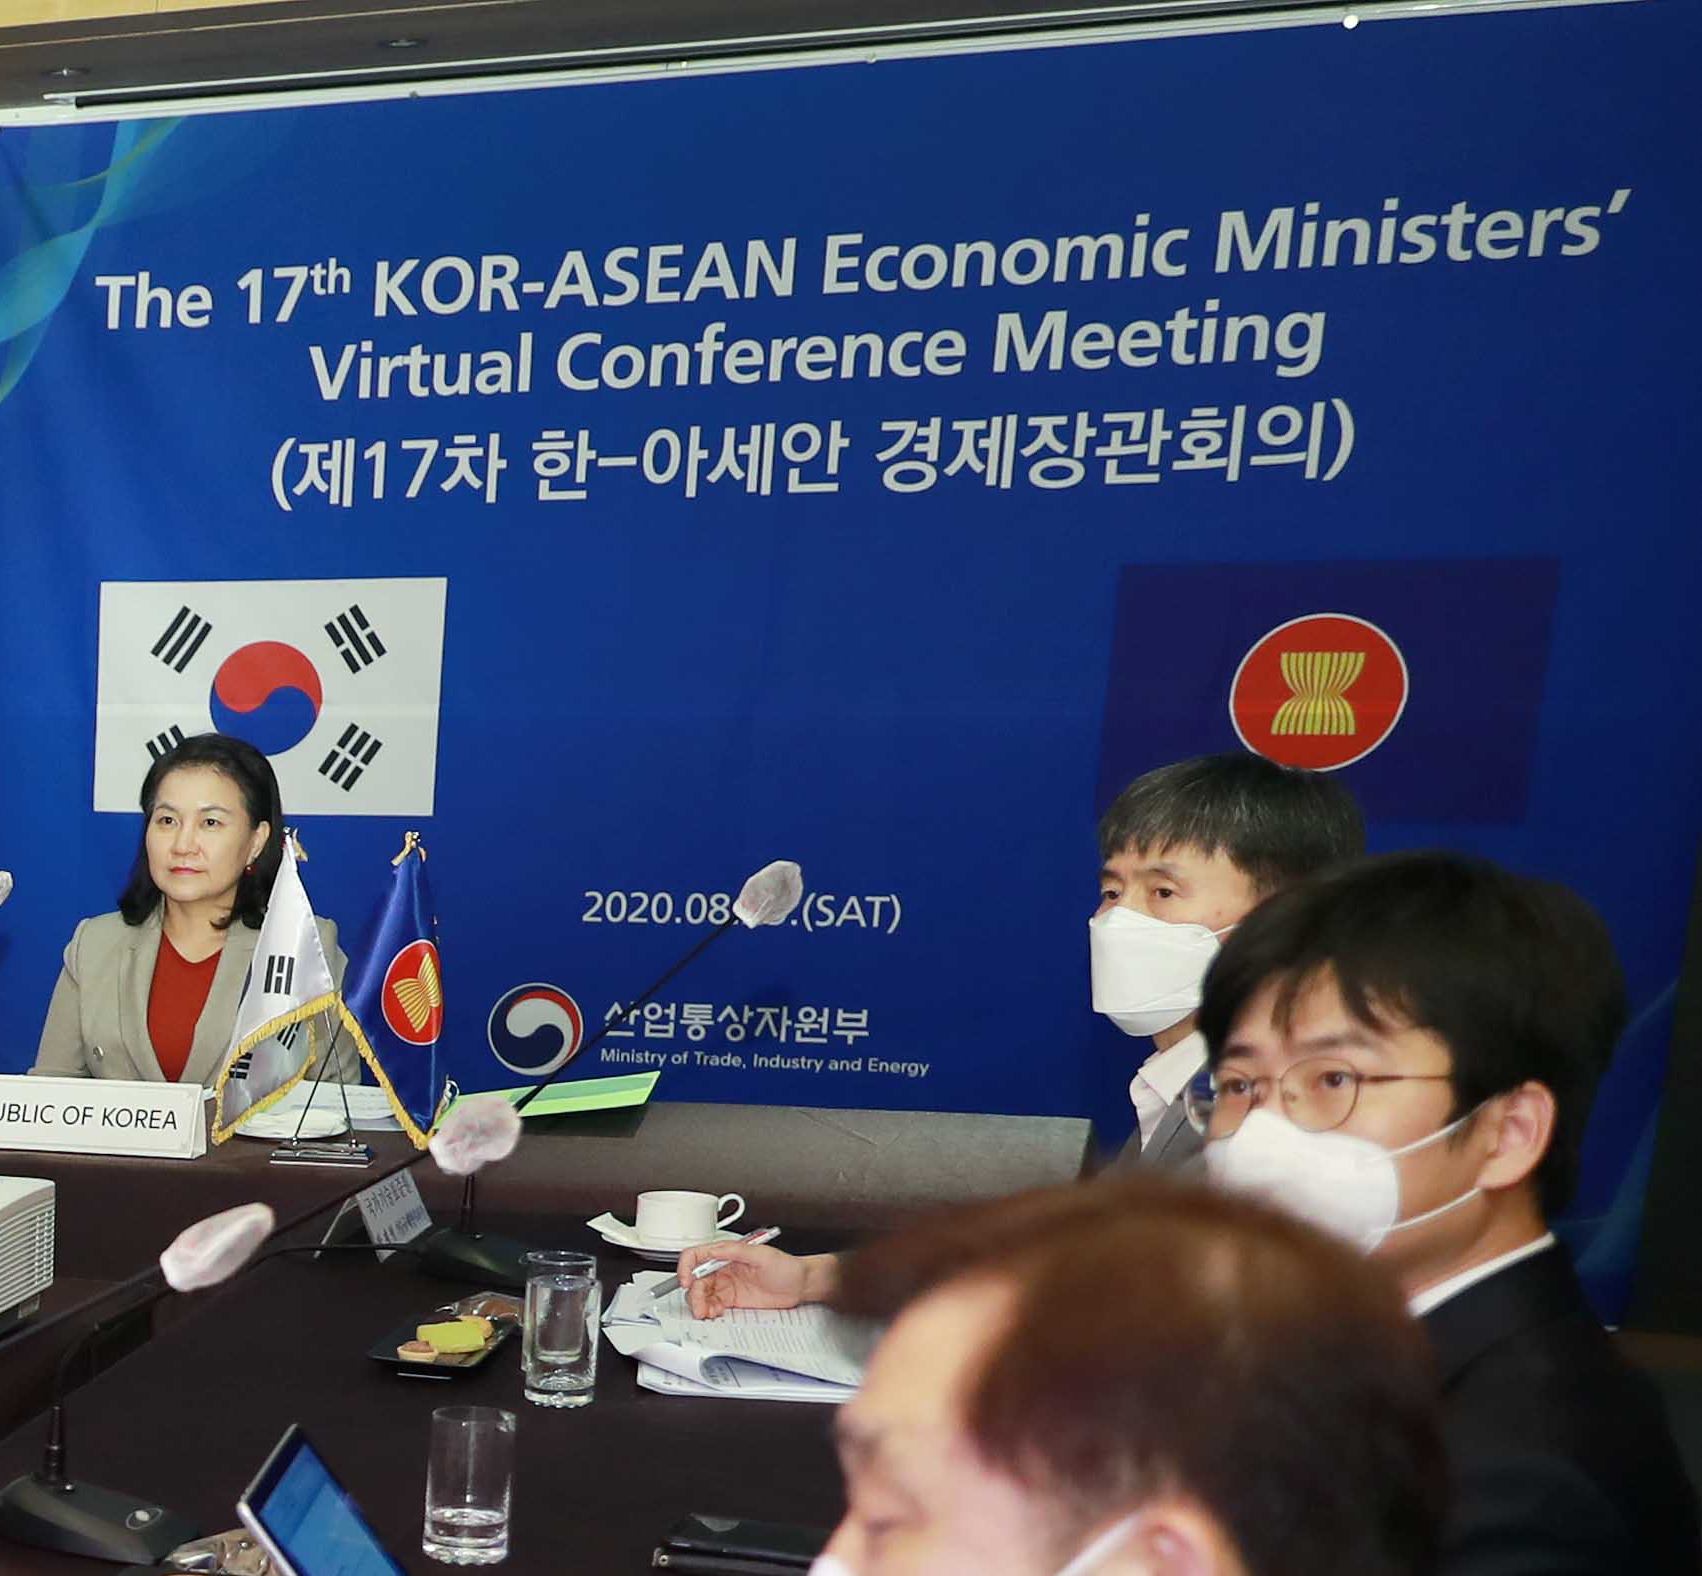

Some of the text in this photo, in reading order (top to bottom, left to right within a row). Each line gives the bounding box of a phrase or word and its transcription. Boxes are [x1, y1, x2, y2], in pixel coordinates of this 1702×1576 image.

[95, 271, 212, 330] The
[235, 257, 352, 325] 17th
[374, 238, 796, 317] KOR-ASEAN
[822, 213, 1189, 295] Economic
[308, 298, 1326, 401] Virtual Conference Meeting
[271, 398, 1355, 512] (제17차 한-아세안 경제장관회의)
[582, 890, 901, 934] 2020.08..(SAT)
[604, 1001, 870, 1045] 산업통상자원부
[600, 1047, 930, 1077] Ministry of Trade, Industry and Energy
[62, 1105, 95, 1126] OF
[101, 1106, 178, 1130] KOREA
